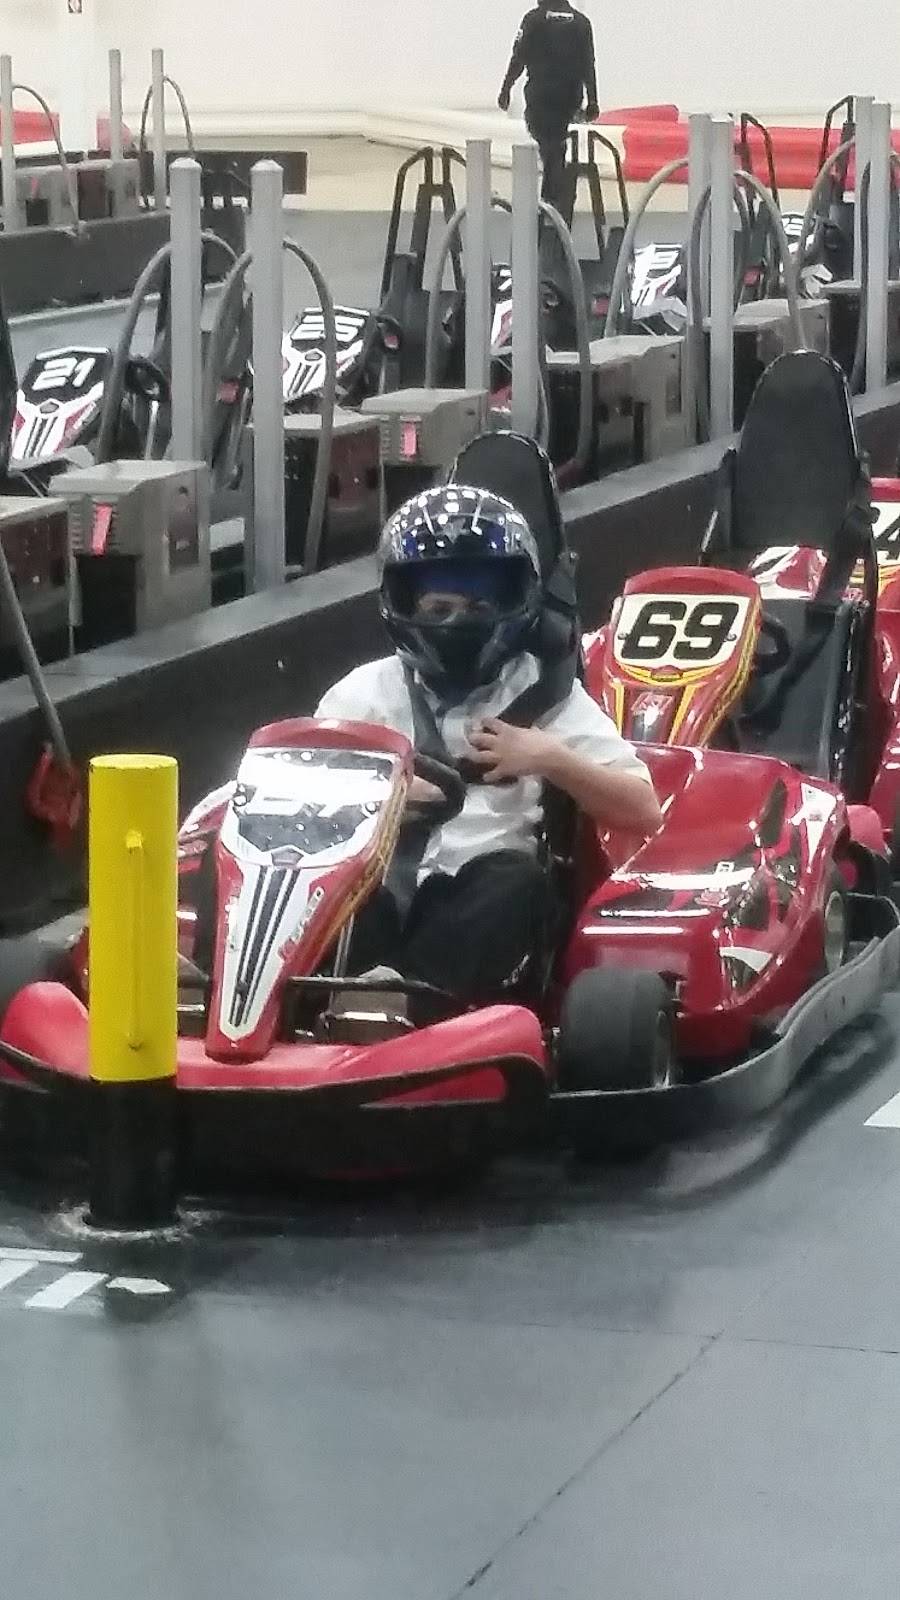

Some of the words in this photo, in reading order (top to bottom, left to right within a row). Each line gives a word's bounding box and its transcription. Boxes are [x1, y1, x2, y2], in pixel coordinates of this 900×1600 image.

[291, 315, 364, 342] 25
[32, 357, 95, 390] 21
[621, 600, 739, 660] 69
